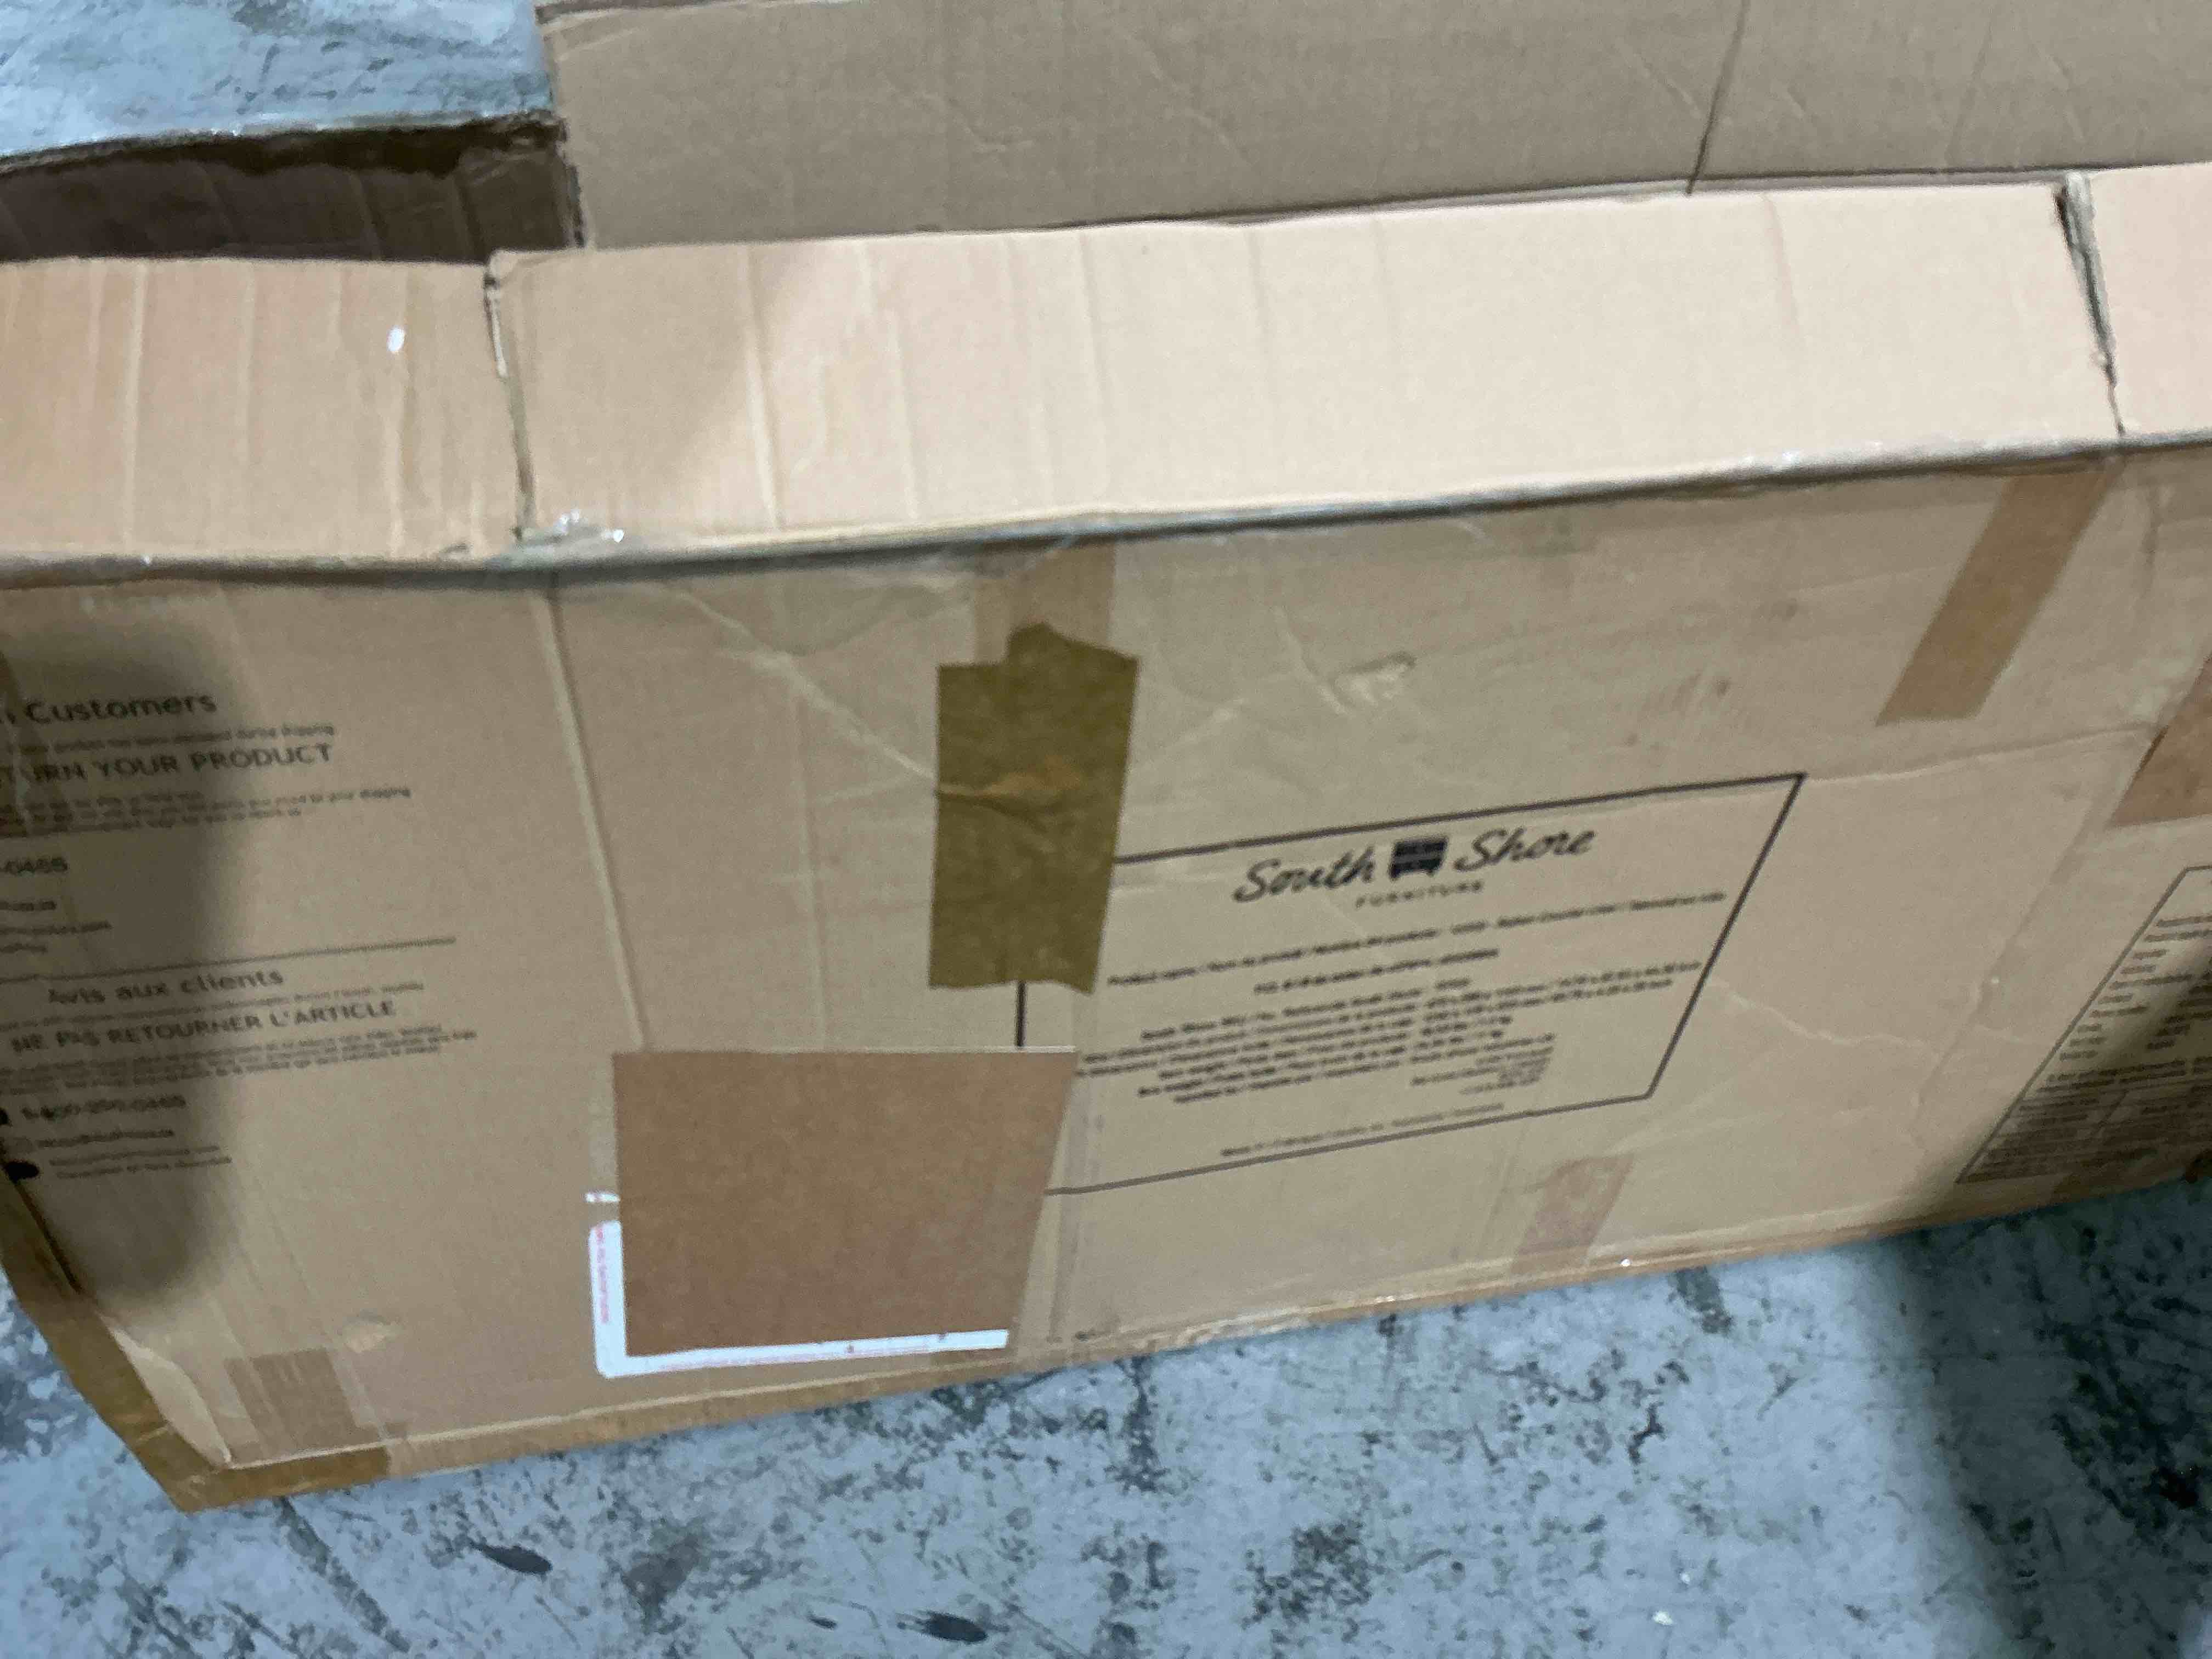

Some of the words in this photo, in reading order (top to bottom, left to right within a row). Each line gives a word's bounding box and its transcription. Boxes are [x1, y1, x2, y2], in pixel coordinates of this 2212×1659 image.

[26, 696, 217, 724] Customers
[93, 754, 180, 777] YOUR
[189, 742, 332, 772] PRODUCT
[1232, 844, 1375, 903] South
[1453, 826, 1596, 873] Shore
[115, 982, 169, 1001] aux
[180, 969, 284, 994] clients
[107, 1013, 263, 1043] RETOURNER
[269, 1000, 397, 1028] L'ARTICLE
